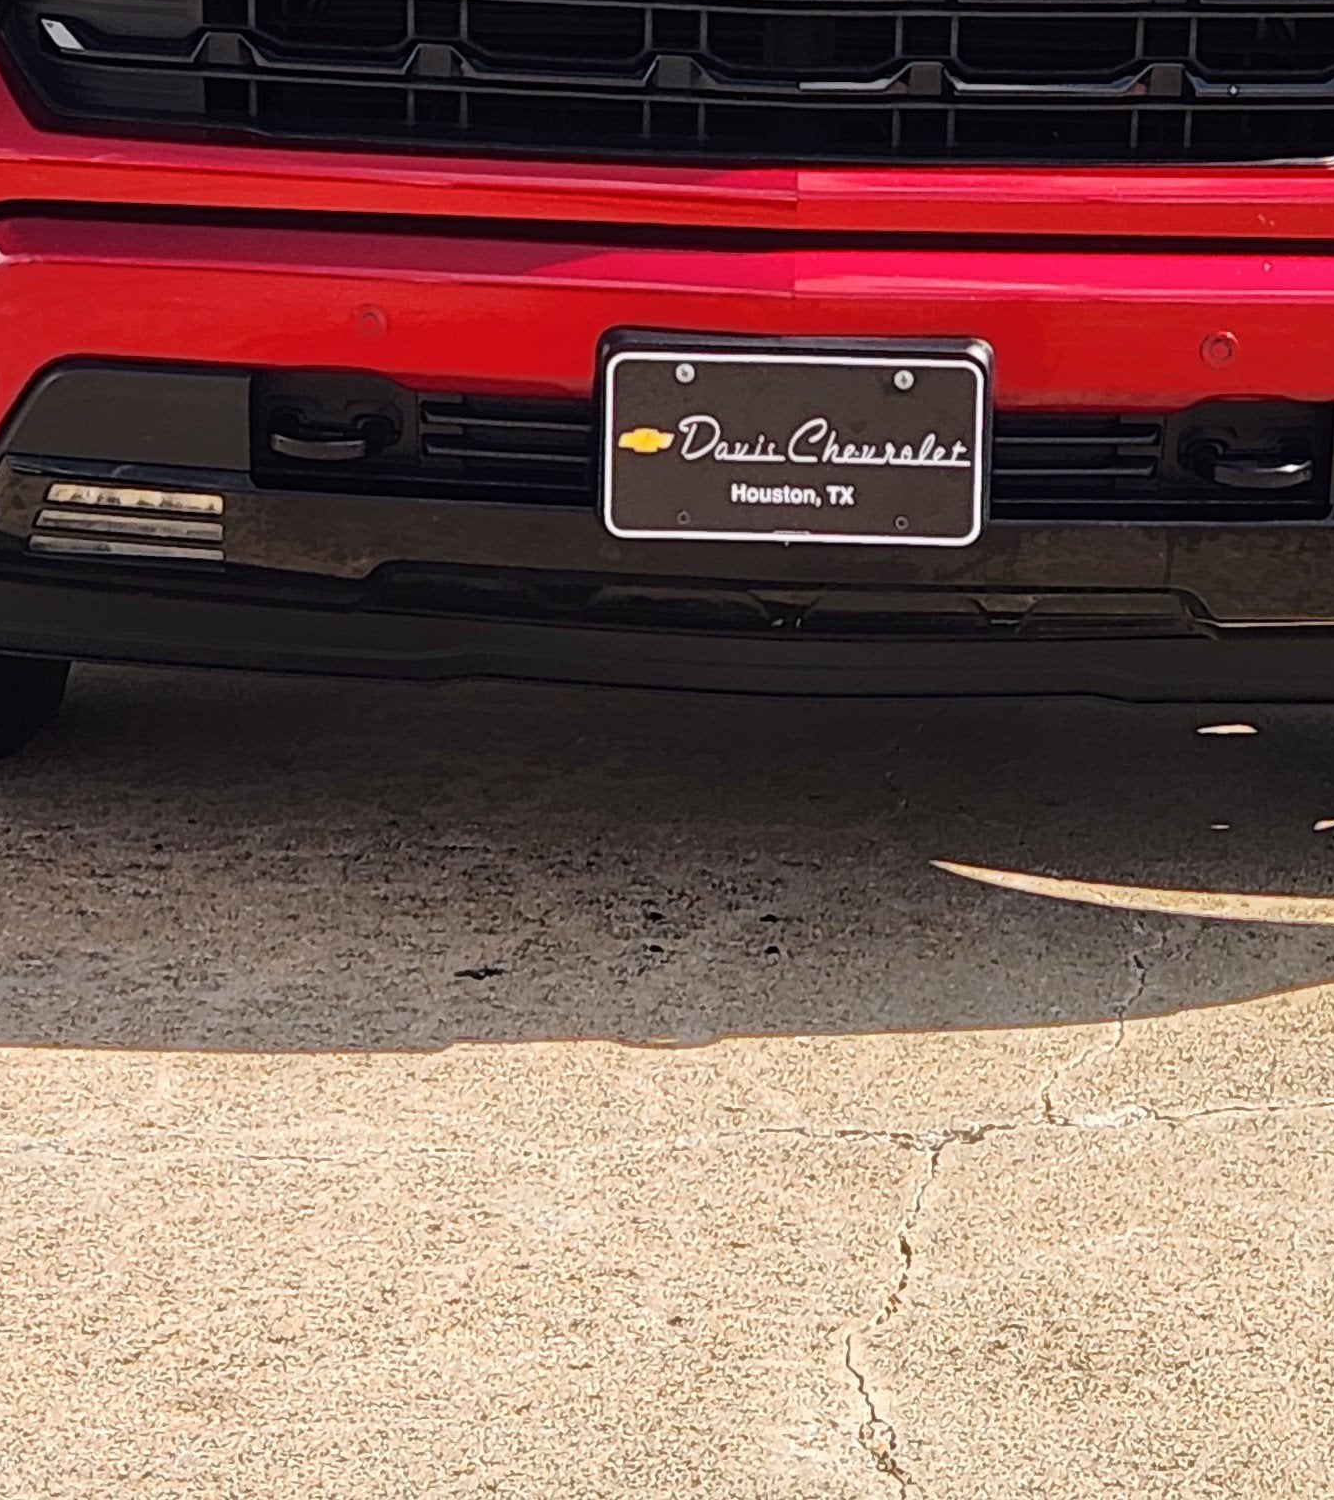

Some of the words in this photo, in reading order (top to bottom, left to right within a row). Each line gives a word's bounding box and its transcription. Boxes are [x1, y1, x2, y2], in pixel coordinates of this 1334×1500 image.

[678, 414, 785, 462] Davis
[787, 417, 971, 467] Chevrolet
[730, 483, 822, 508] Houston,
[826, 485, 855, 506] TX
